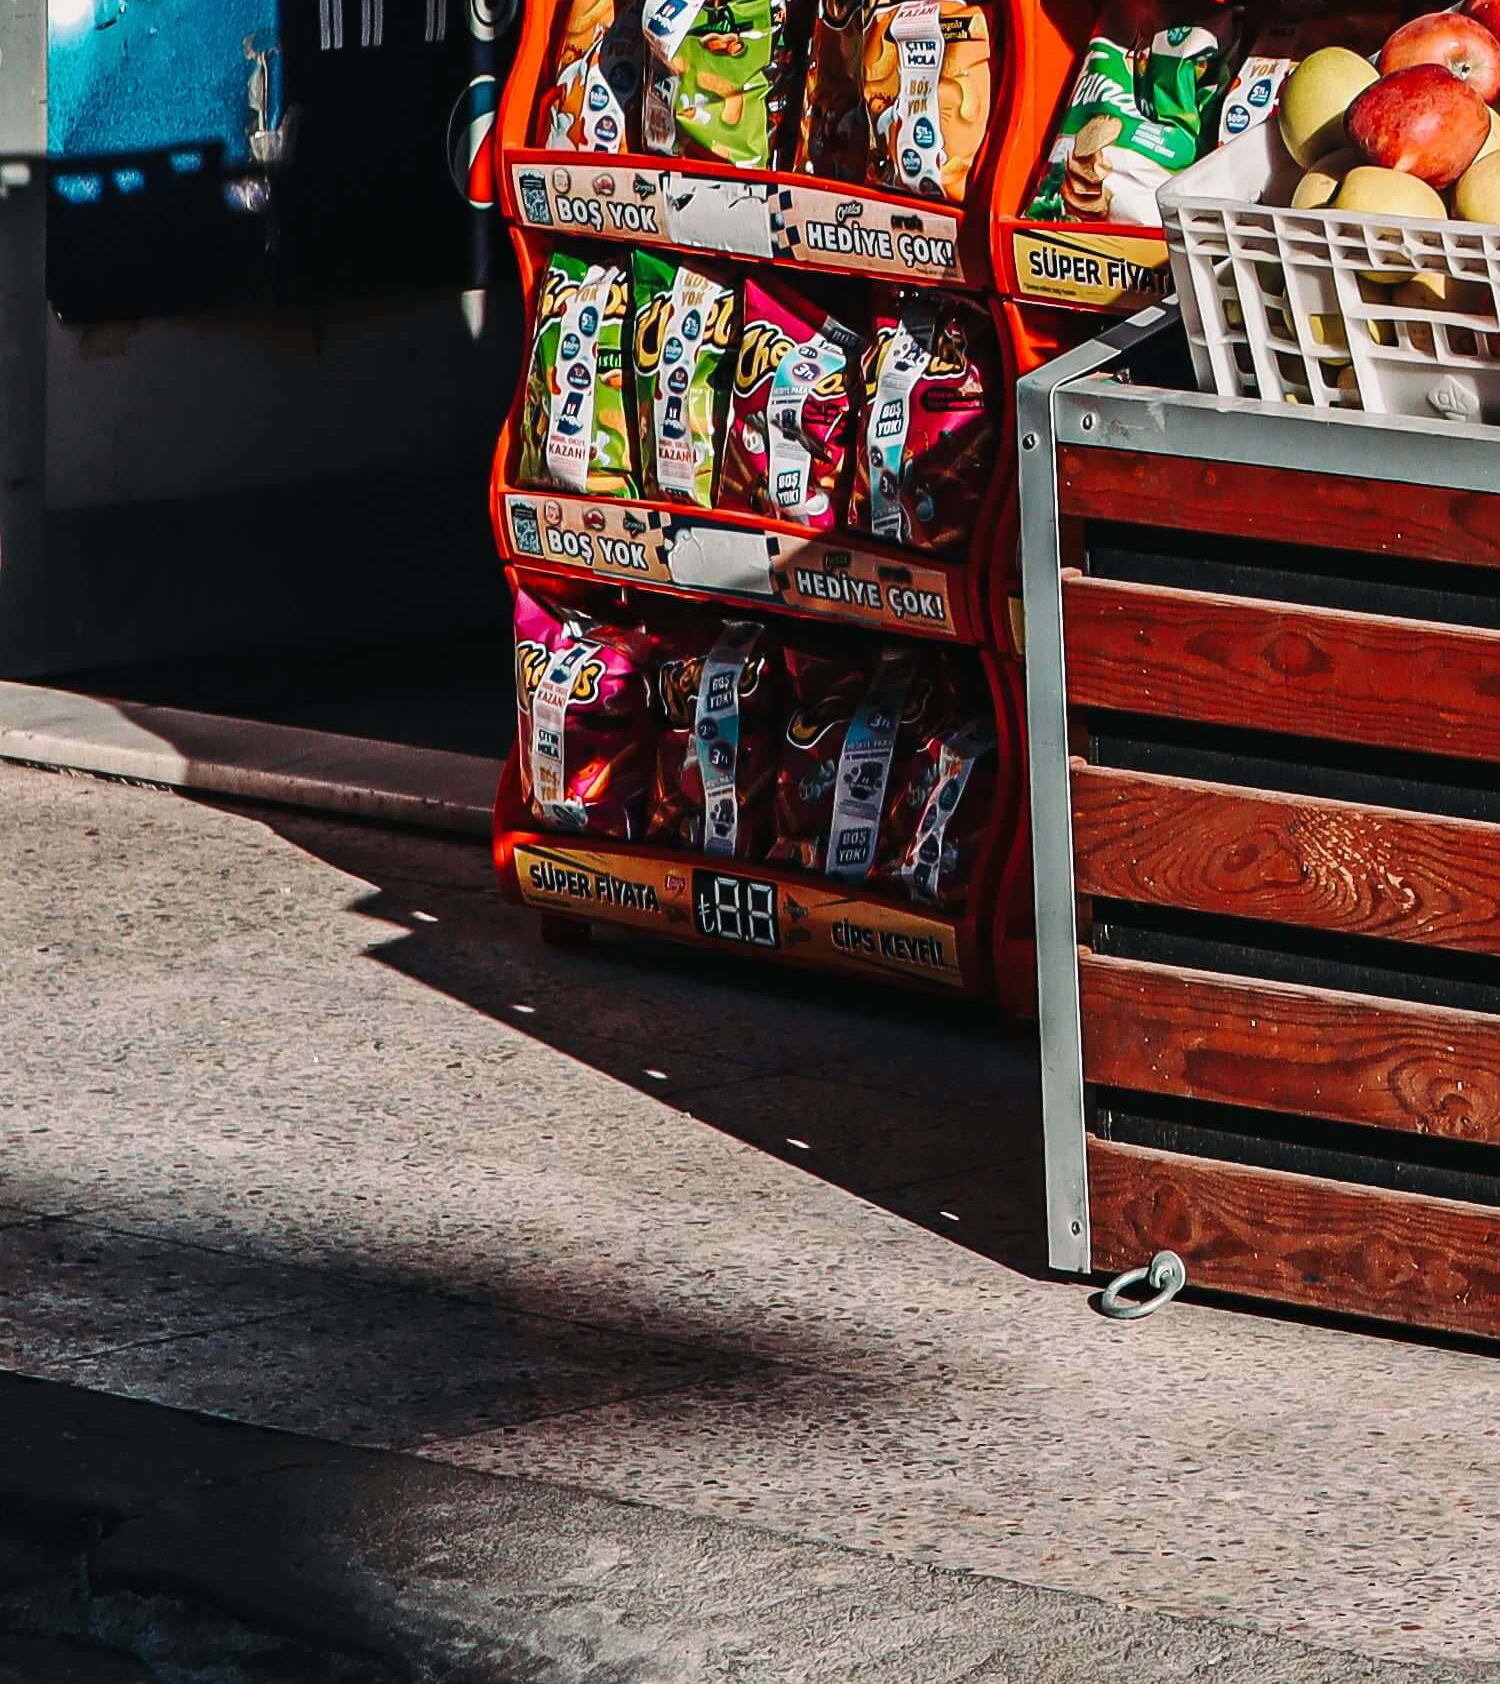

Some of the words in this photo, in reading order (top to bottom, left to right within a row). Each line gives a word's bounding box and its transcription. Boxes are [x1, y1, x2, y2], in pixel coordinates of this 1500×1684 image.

[556, 197, 604, 231] BOŞ
[609, 202, 657, 233] YOK
[807, 220, 893, 259] HEDİYE
[899, 235, 954, 267] ÇOK!
[1028, 247, 1104, 287] SÜPER
[777, 471, 800, 491] BOŞ
[546, 528, 594, 564] BOŞ
[598, 535, 648, 569] YOK
[796, 569, 882, 608] HEDİYE
[888, 586, 945, 619] ÇOK!
[530, 863, 592, 900] SÜPER
[596, 870, 662, 914] FİYATA
[830, 919, 876, 953] CİPS
